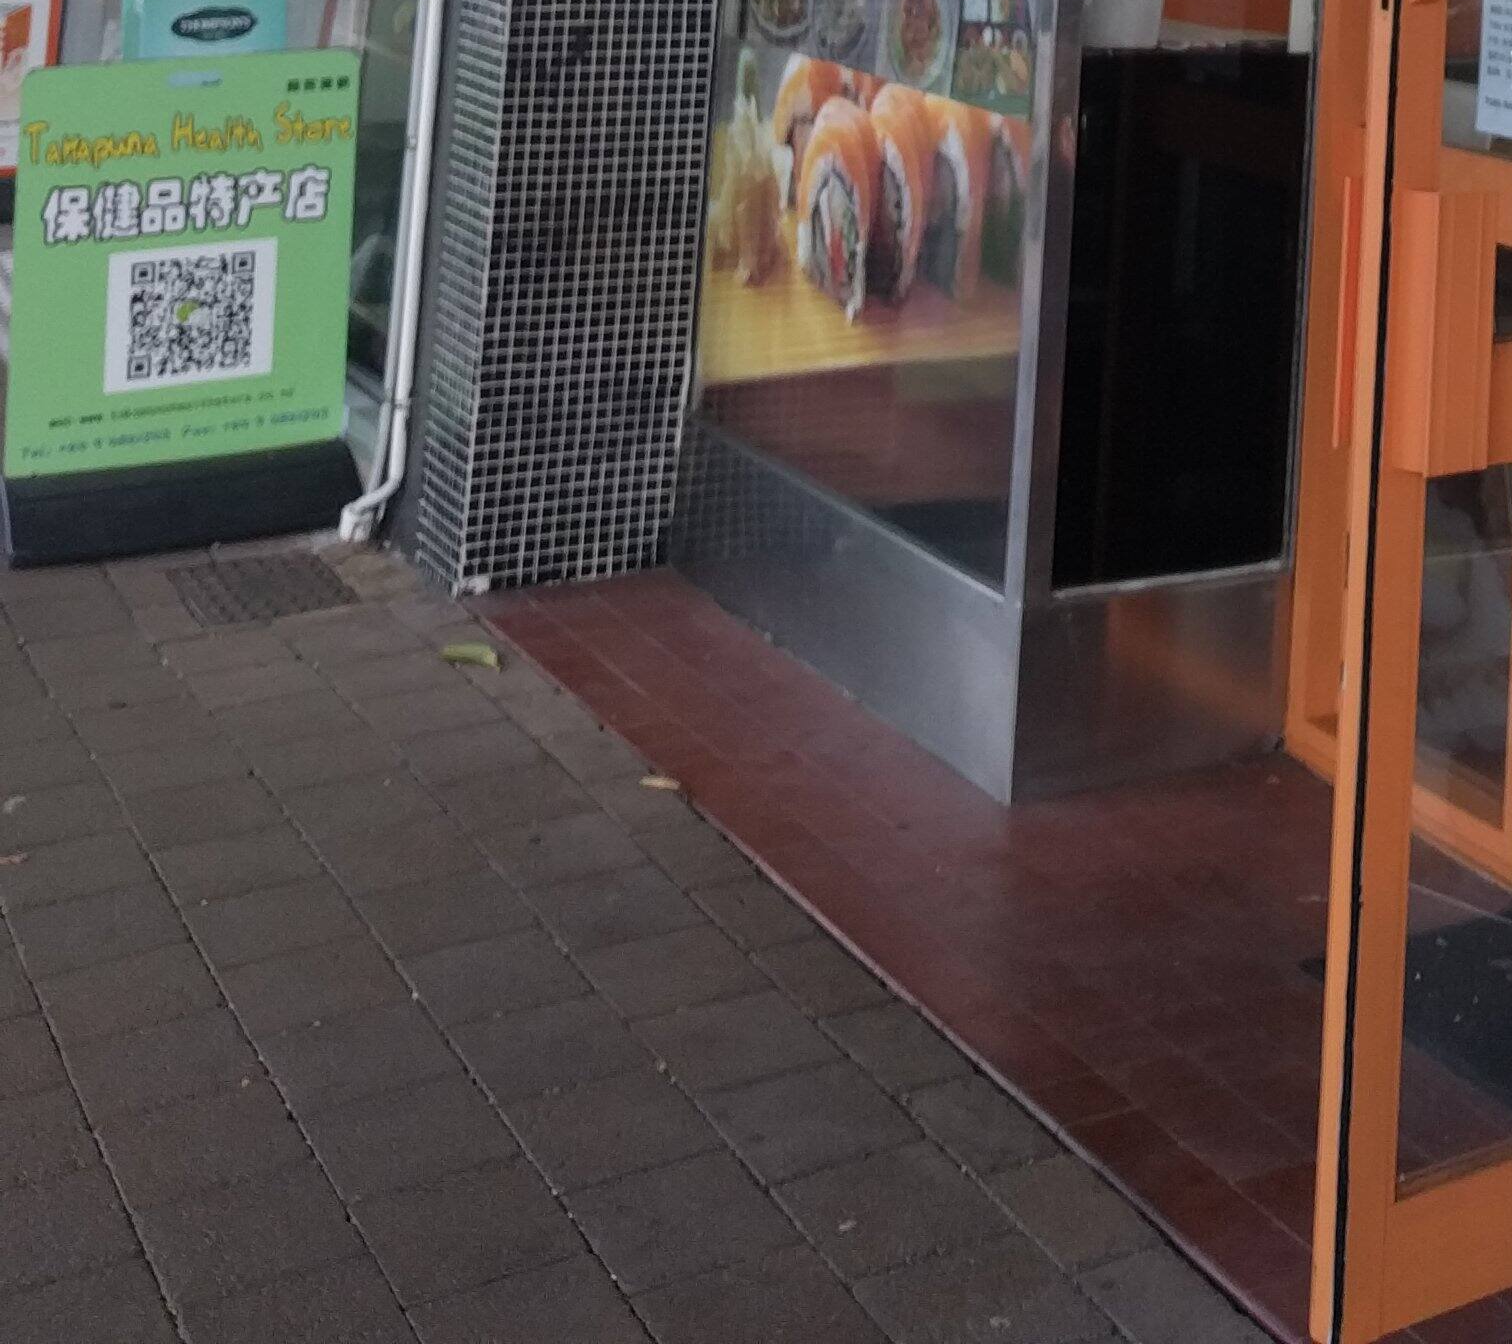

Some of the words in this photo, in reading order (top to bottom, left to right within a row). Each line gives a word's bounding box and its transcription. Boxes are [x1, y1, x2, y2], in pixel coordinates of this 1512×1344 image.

[22, 119, 161, 170] Takapuna
[170, 110, 264, 154] Health
[273, 99, 352, 146] Store
[42, 162, 333, 249] 保健品特产店
